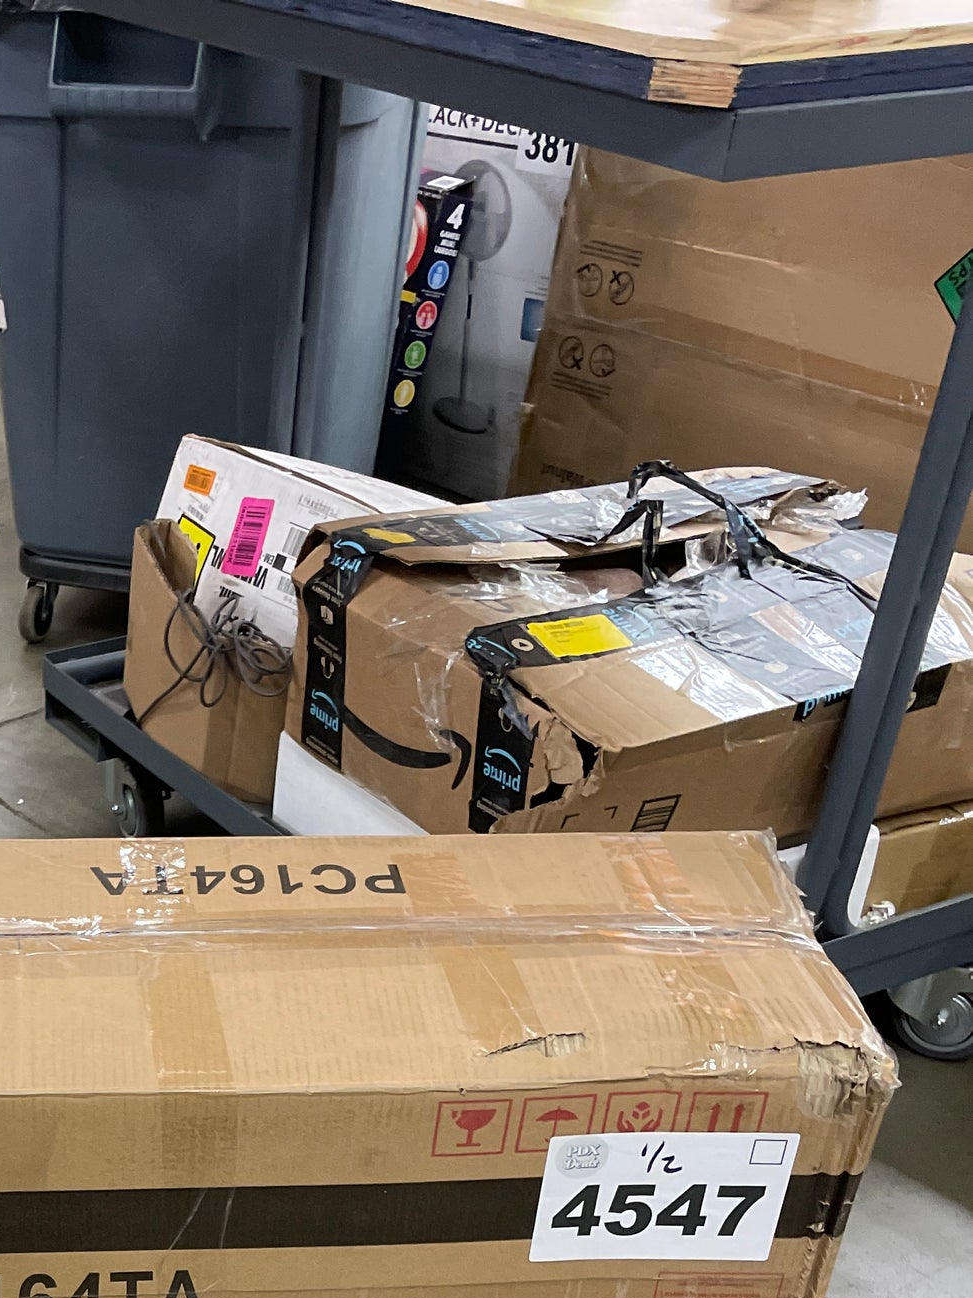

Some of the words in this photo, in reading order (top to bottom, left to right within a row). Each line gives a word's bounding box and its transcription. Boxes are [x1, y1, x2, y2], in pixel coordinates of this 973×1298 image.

[446, 203, 465, 229] 4
[310, 702, 339, 733] prime
[483, 761, 522, 793] prime
[89, 863, 407, 896] PC164TA
[566, 1143, 602, 1157] PDX
[641, 1140, 683, 1173] 1/2
[551, 1183, 767, 1236] 4547
